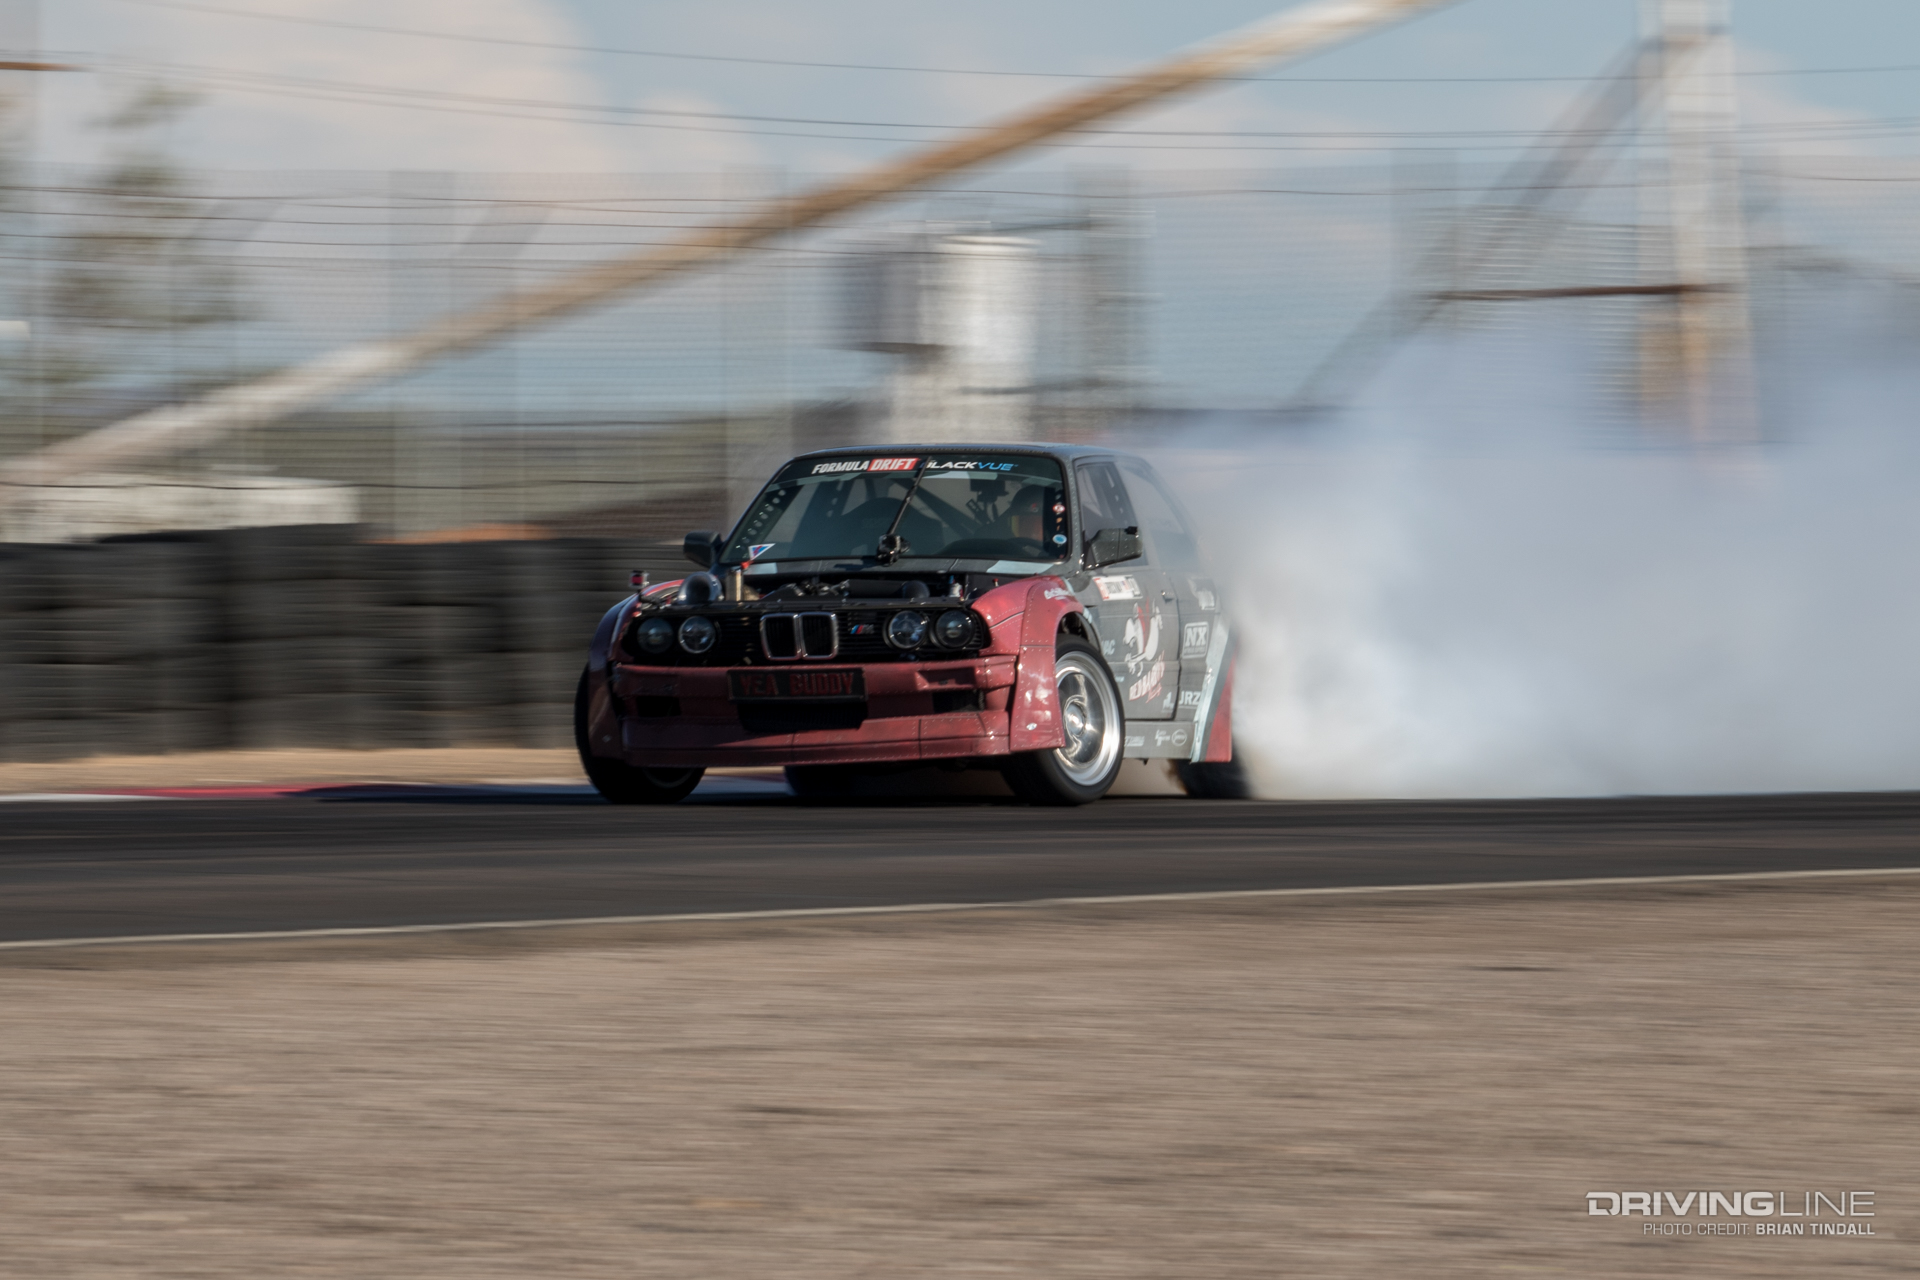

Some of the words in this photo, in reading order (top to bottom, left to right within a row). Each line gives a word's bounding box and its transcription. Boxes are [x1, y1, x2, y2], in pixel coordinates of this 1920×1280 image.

[811, 459, 869, 475] FORMULA
[869, 458, 915, 471] DRIFT
[1185, 626, 1207, 647] NX
[739, 673, 779, 695] YEA
[789, 672, 855, 696] BUDDY
[1178, 690, 1201, 705] JRZ
